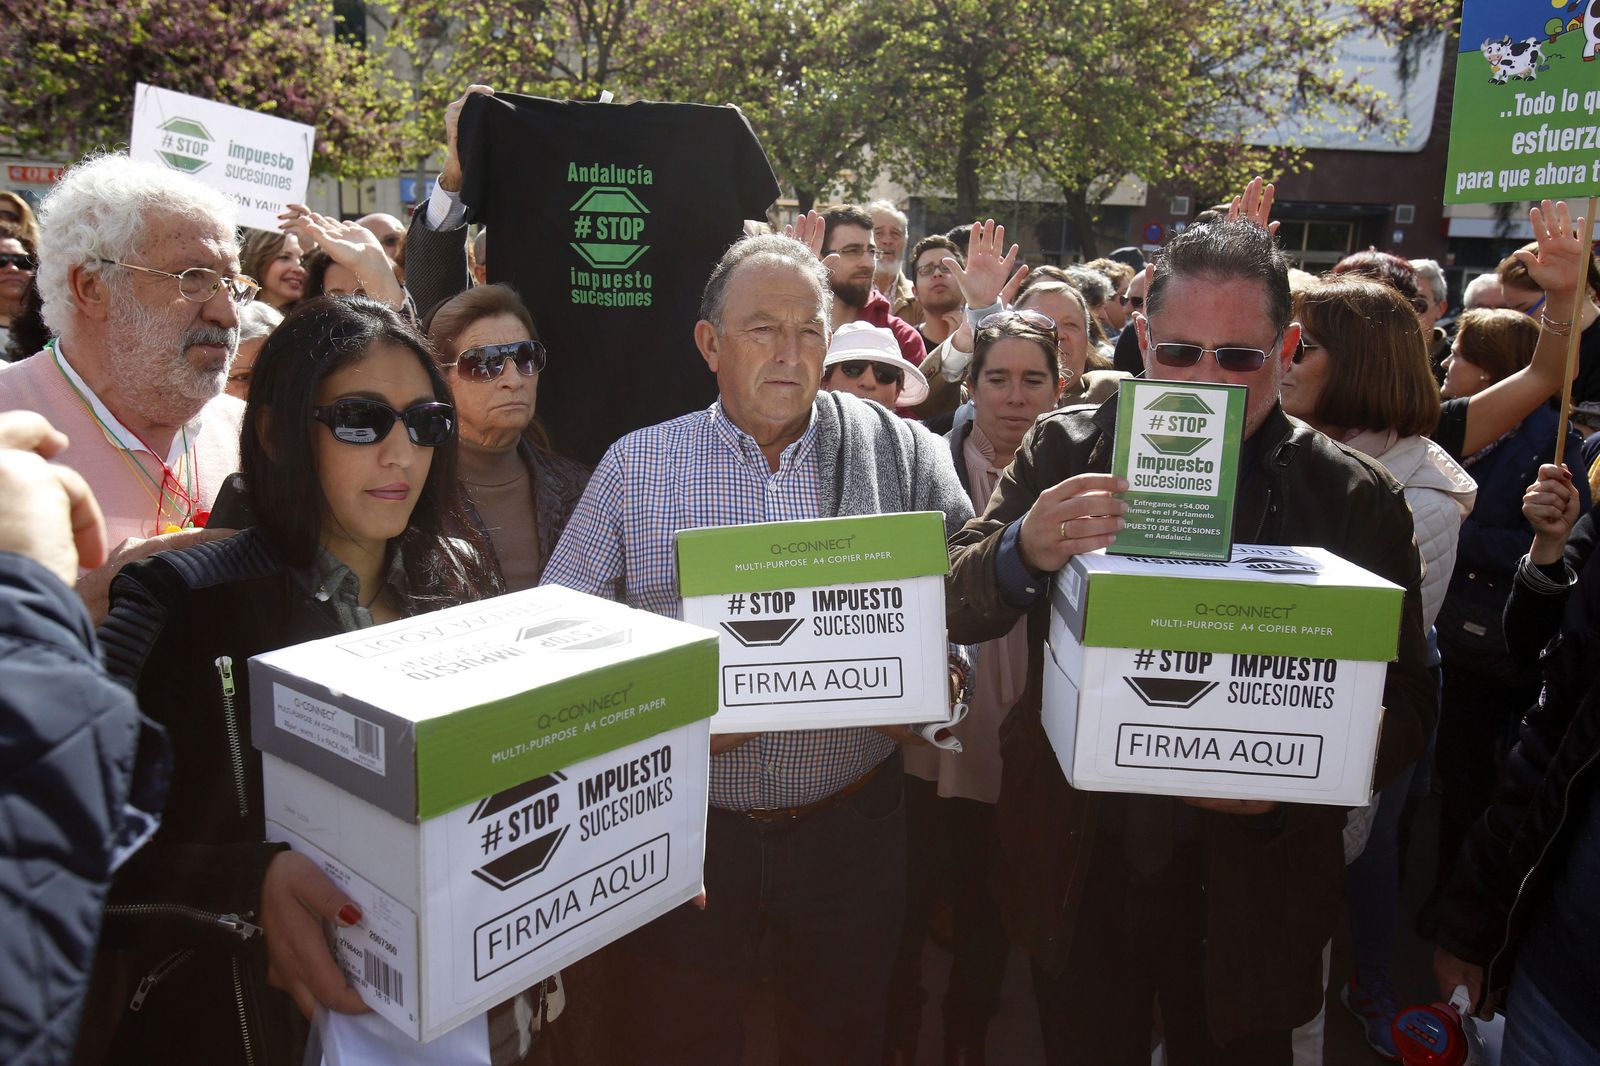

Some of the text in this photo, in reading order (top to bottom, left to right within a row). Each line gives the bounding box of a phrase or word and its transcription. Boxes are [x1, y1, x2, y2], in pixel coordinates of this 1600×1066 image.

[1560, 88, 1579, 113] lo
[228, 140, 294, 171] impuesto
[225, 164, 292, 191] sucesiones
[567, 162, 653, 185] Andalucía
[1456, 170, 1493, 195] para
[1498, 168, 1530, 192] que
[1535, 162, 1586, 186] ahora
[570, 267, 652, 290] impuesto
[571, 288, 652, 307] sucesiones
[1136, 452, 1214, 474] impuesto
[1134, 472, 1213, 492] sucesiones
[1133, 499, 1210, 511] Entregamos +54.000
[1163, 508, 1170, 516] el
[1172, 510, 1215, 519] Parlamento
[1156, 517, 1180, 525] contra
[1171, 526, 1221, 536] SUCESIONES
[1155, 532, 1192, 541] Andalucía
[735, 551, 892, 571] MULTI-PURPOSE A4 COPIER PAPER
[812, 587, 903, 612] IMPUESTO
[813, 612, 905, 637] SUCESIONES
[1150, 618, 1334, 636] MULTI-PURPOSE A4 COPIER PAPER
[734, 666, 888, 695] FIRMA AQUI
[1231, 653, 1338, 683] IMPUESTO
[1227, 681, 1335, 710] SUCESIONES
[491, 697, 667, 764] MULTI-PURPOSE A4 COPIER PAPER
[1129, 732, 1305, 768] FIRMA AQUI
[577, 745, 672, 811] IMPUESTO
[579, 776, 673, 842] SUCESIONES
[489, 850, 654, 960] FIRMA AQUI
